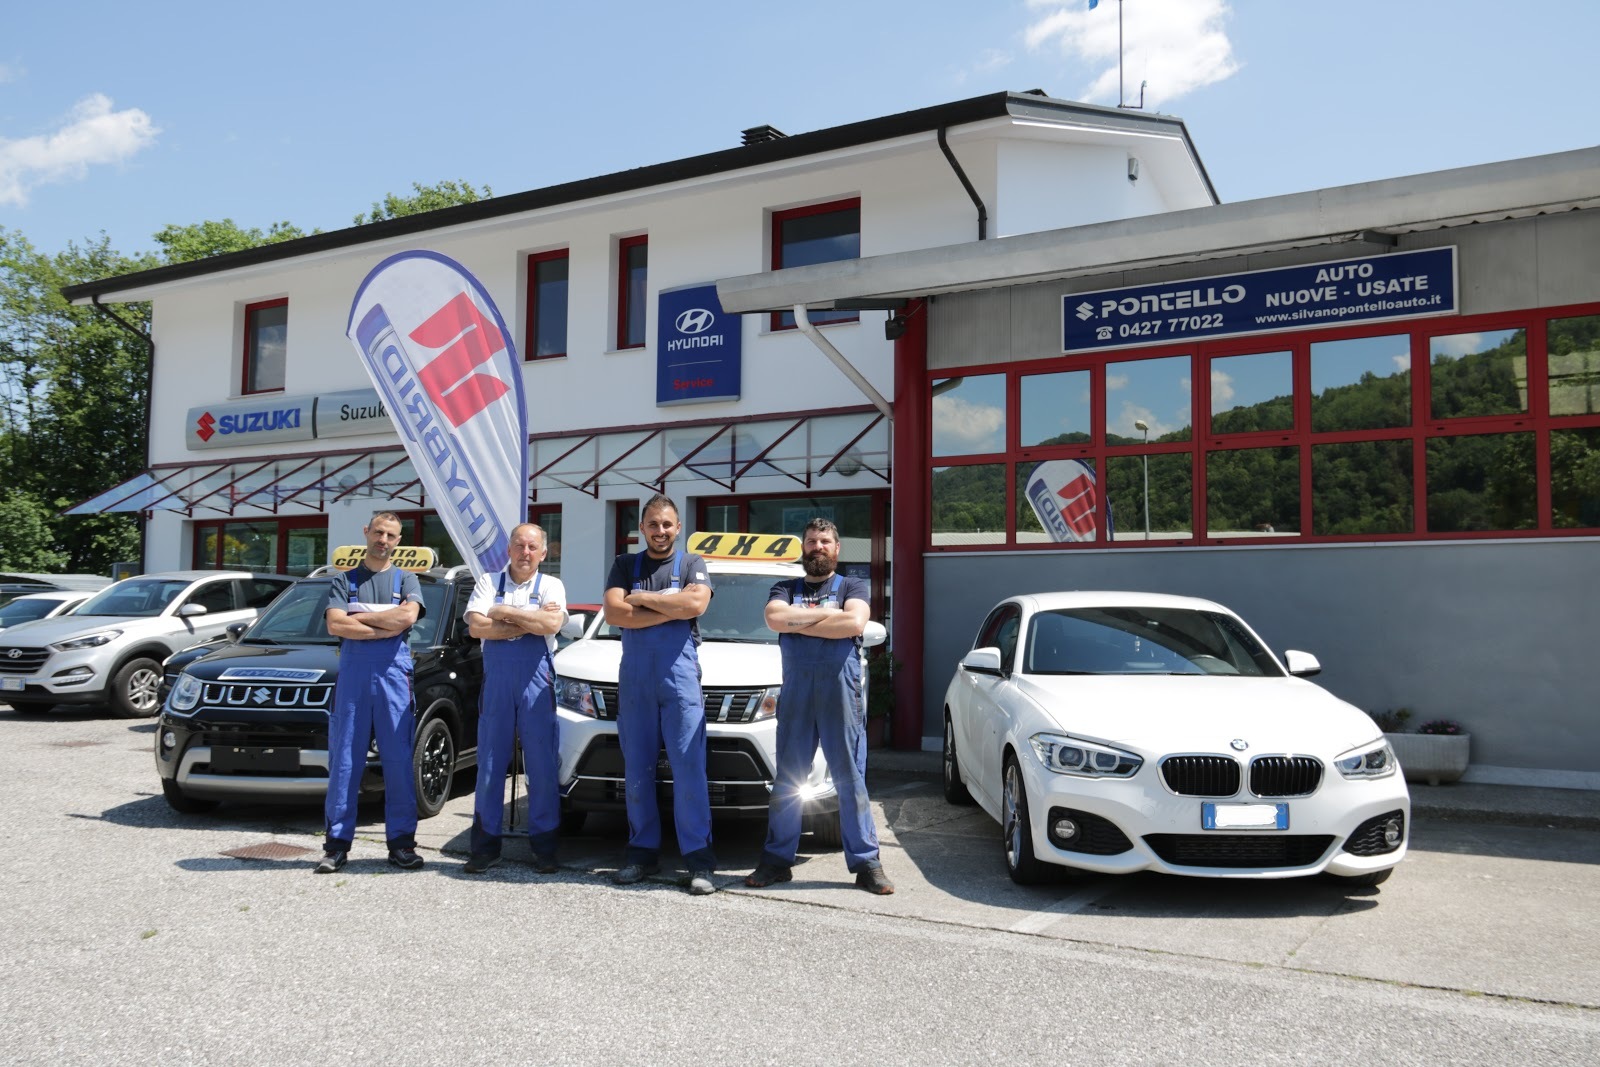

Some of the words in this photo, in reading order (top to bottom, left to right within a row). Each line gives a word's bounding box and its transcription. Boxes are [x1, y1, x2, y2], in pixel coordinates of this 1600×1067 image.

[1315, 263, 1374, 284] AUTO
[1265, 286, 1338, 308] NUOVE
[1357, 275, 1429, 297] USATE
[1255, 294, 1442, 324] www.silvanopontelloauto.it
[1119, 320, 1162, 338] 0427
[1168, 313, 1224, 332] 77022
[667, 335, 724, 352] HYUNDAI
[673, 377, 715, 390] Service
[218, 408, 301, 435] SUZUKI
[340, 401, 389, 421] Suzuk
[239, 670, 308, 678] HYBRID
